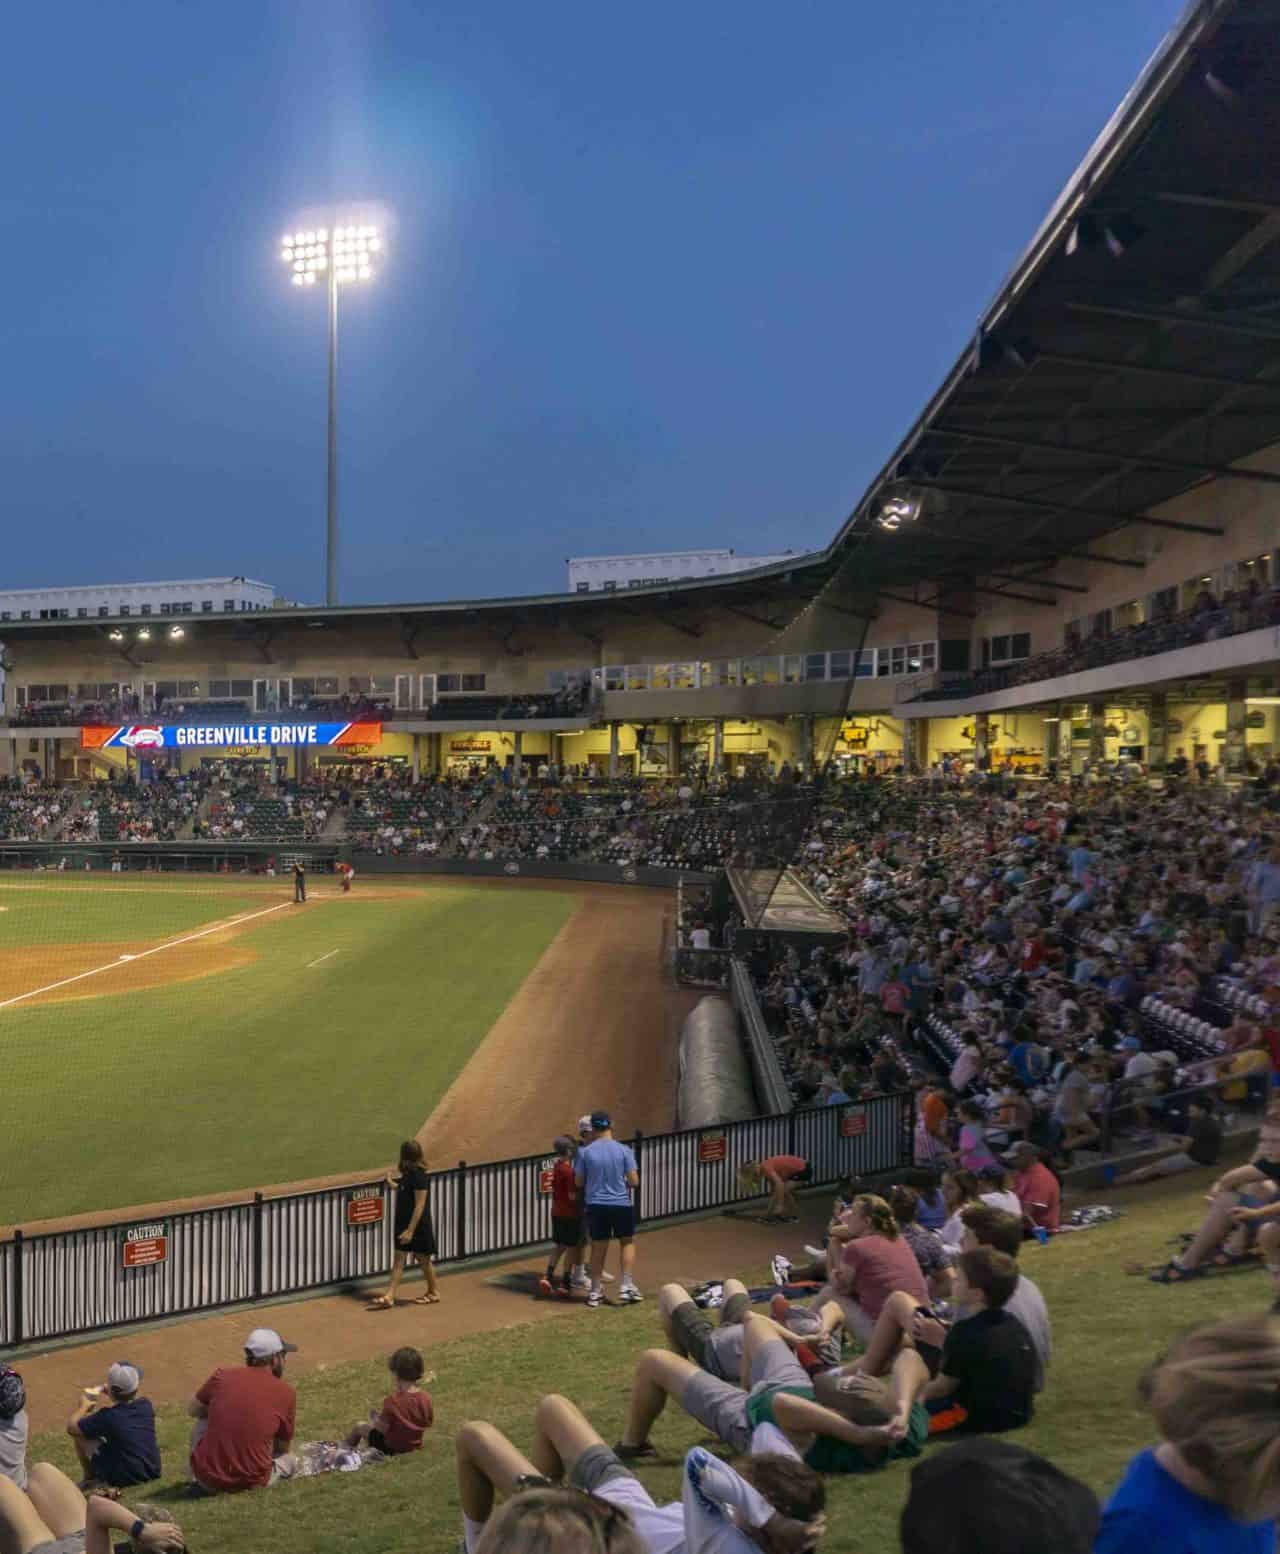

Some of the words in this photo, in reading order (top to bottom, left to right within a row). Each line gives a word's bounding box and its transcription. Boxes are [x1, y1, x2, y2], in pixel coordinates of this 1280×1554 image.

[176, 726, 267, 745] GREENVILLE
[271, 725, 317, 743] DRIVE
[127, 1224, 165, 1241] CAUTION
